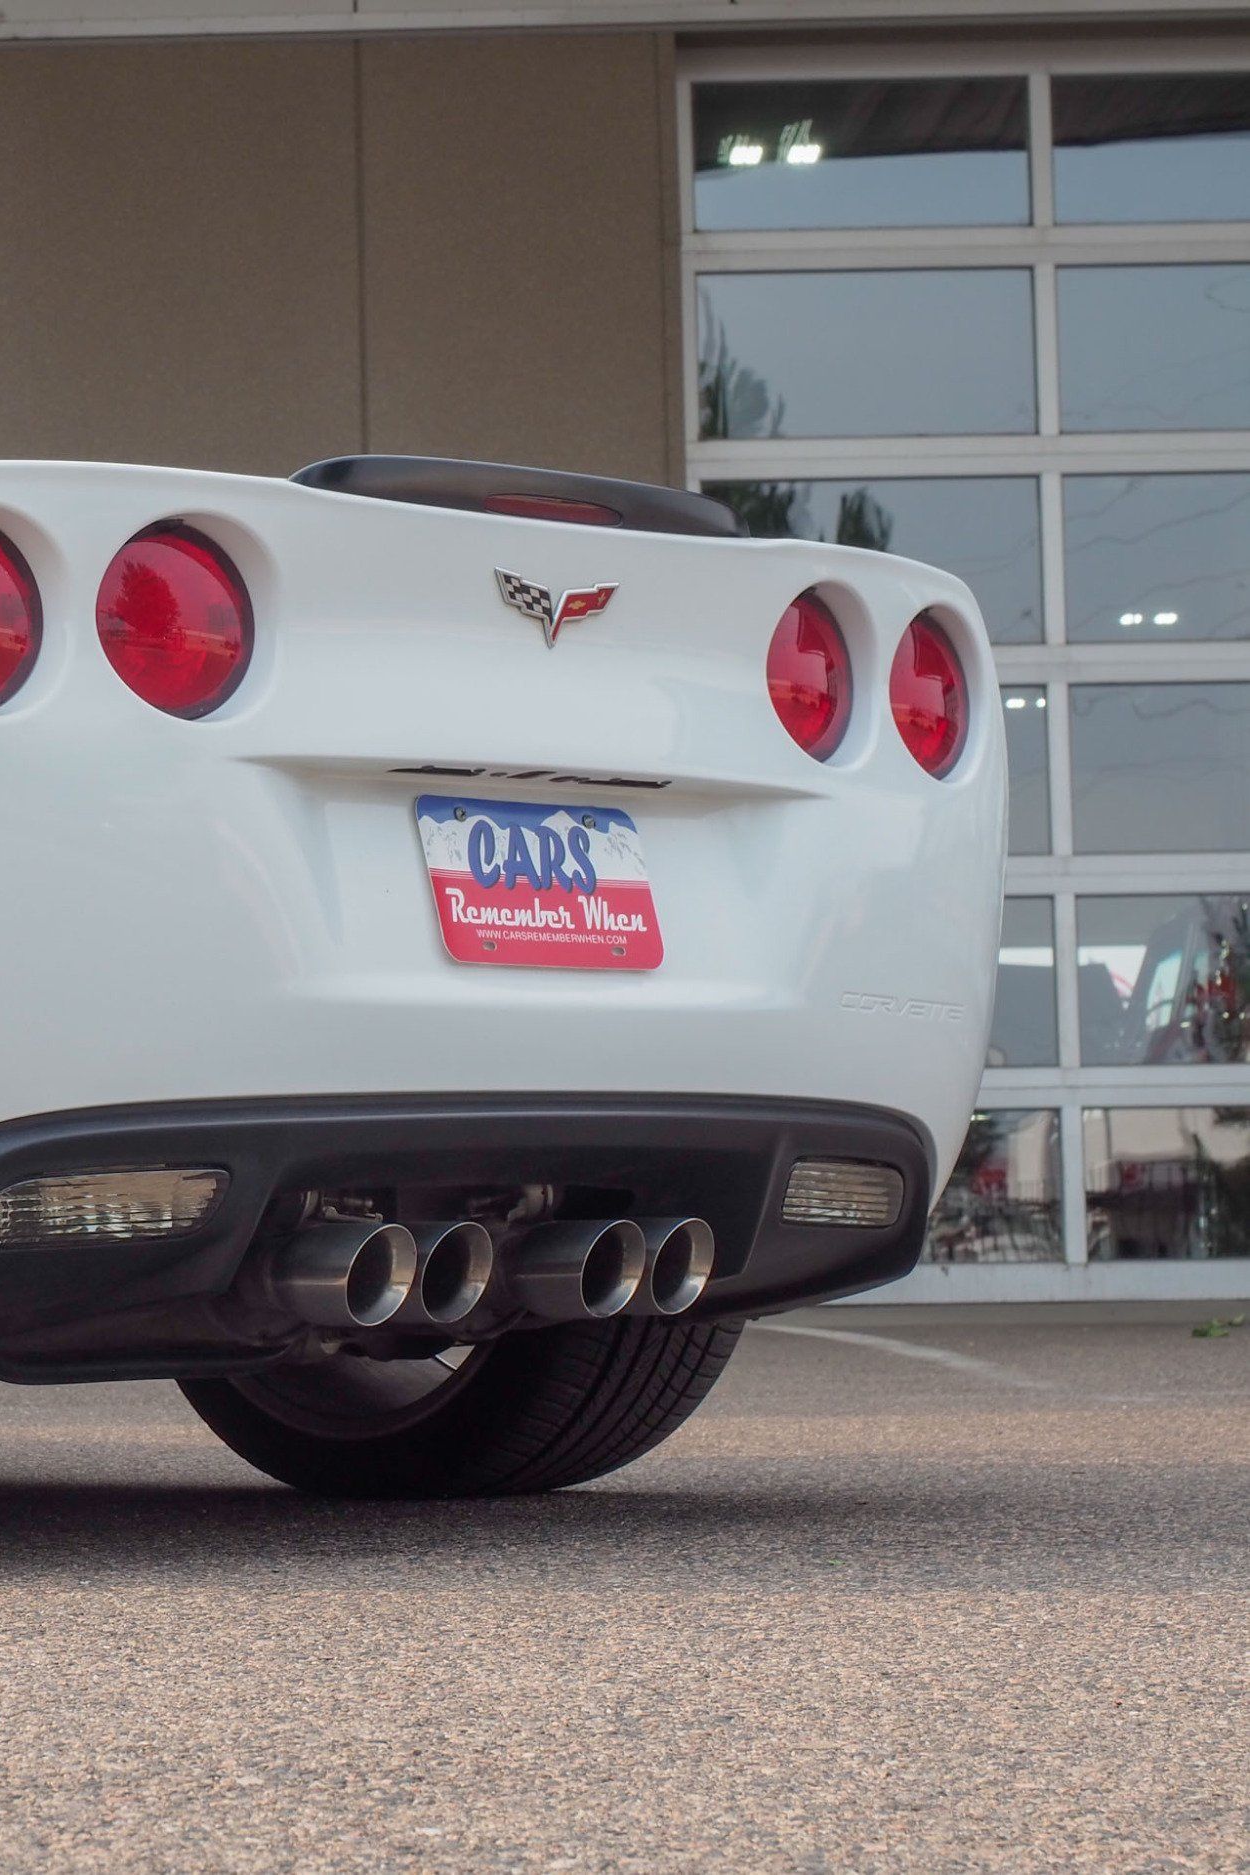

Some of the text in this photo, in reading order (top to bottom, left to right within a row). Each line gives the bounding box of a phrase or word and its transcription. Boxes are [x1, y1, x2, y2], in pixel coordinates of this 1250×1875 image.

[468, 820, 596, 895] CARS
[446, 888, 647, 932] Remember When
[477, 929, 627, 945] WWW.CARSREMEMBERWHEN.COM
[840, 991, 964, 1022] CORVETTE
